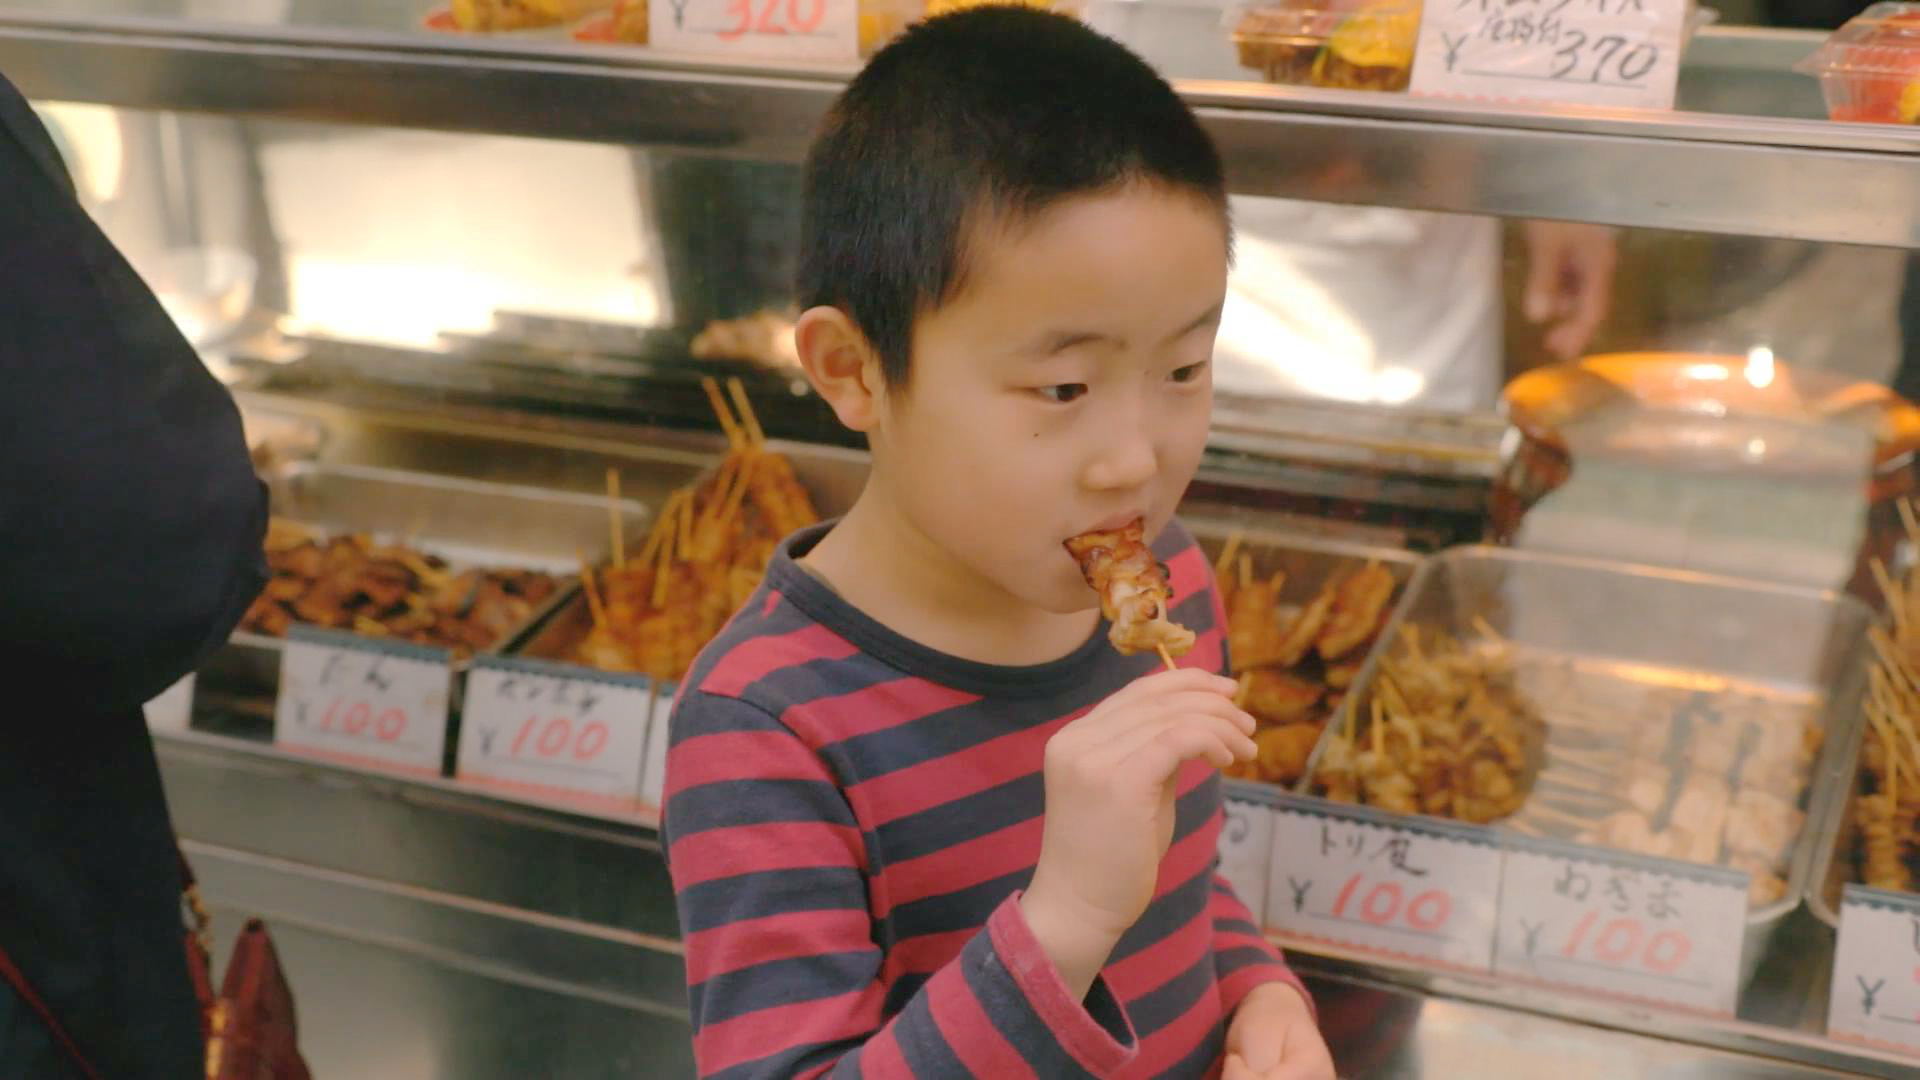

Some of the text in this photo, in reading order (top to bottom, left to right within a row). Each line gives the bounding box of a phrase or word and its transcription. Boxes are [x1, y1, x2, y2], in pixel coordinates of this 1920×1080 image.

[717, 0, 826, 41] 320
[1442, 30, 1660, 83] ¥ 370
[319, 698, 408, 742] 100
[478, 714, 609, 761] ¥ 100
[1288, 872, 1453, 932] ¥ 100
[1519, 909, 1694, 974] ¥ 100
[1856, 974, 1886, 1017] ¥
